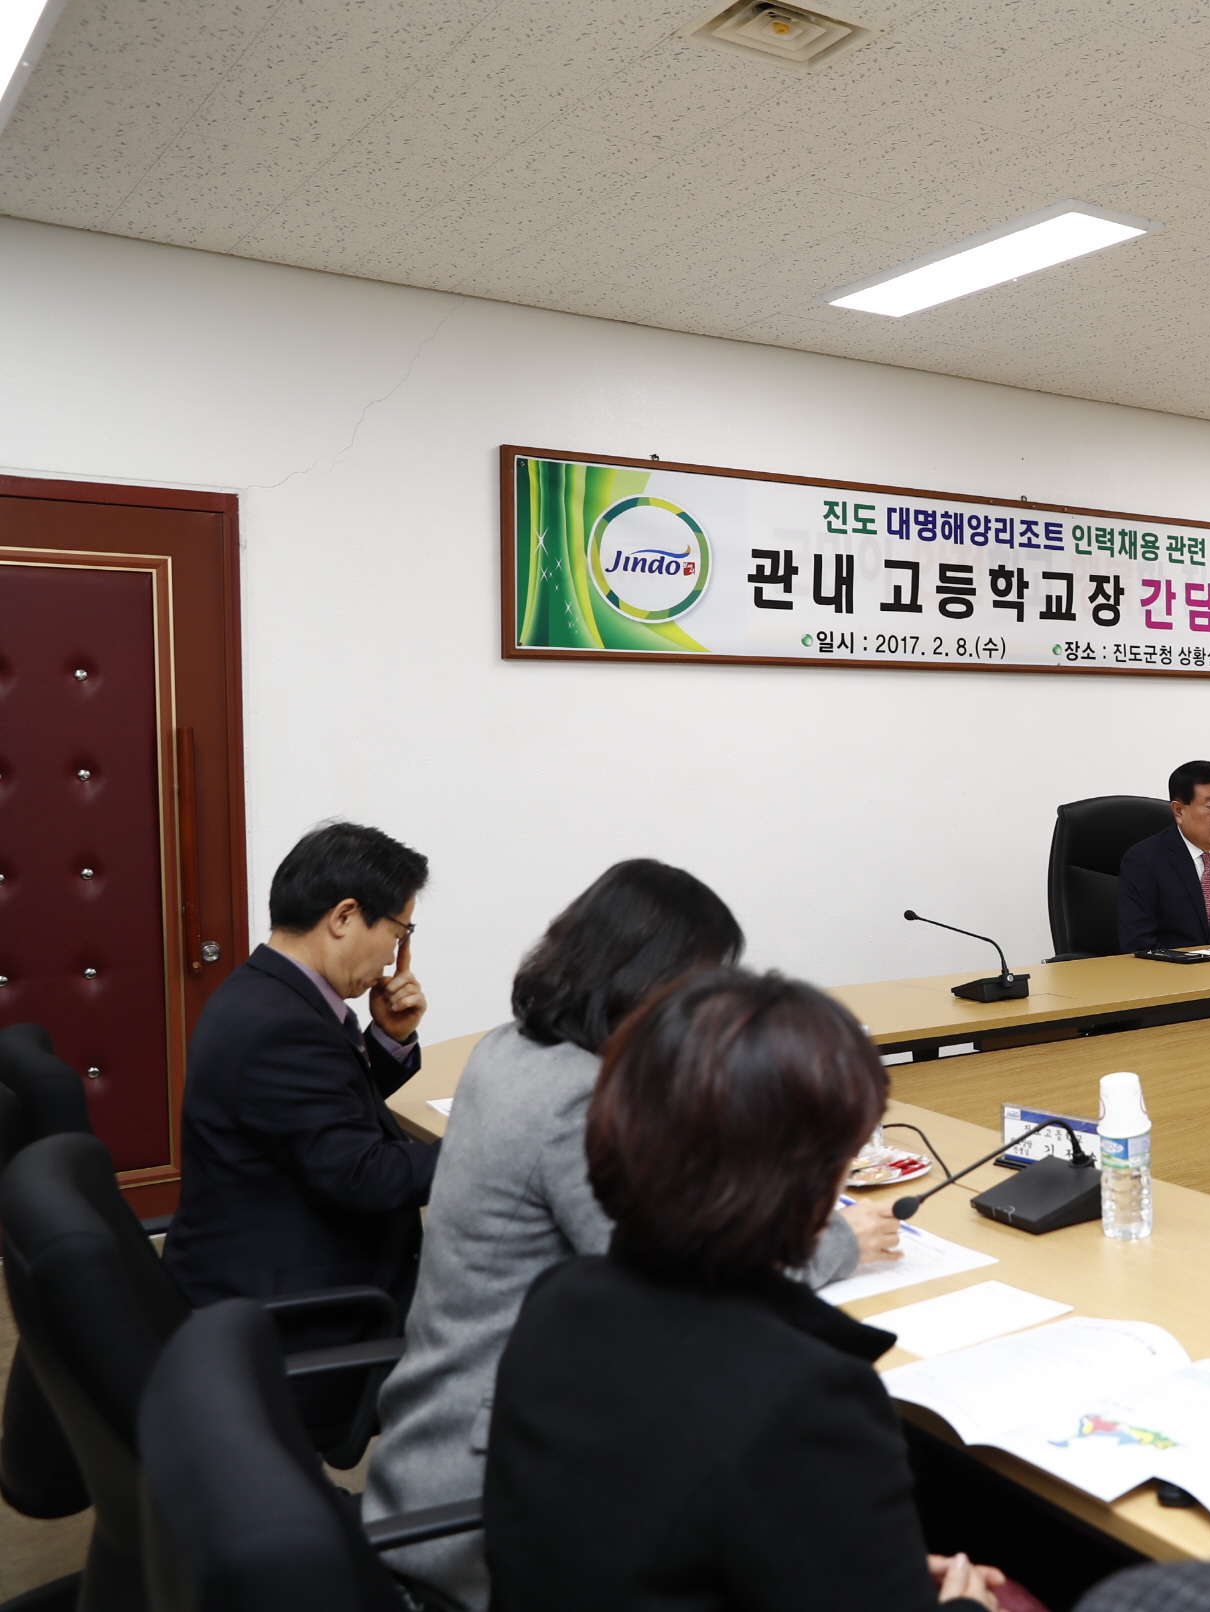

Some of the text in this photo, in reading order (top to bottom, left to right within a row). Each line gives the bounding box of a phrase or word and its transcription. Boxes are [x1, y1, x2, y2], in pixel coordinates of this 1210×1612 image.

[823, 500, 1206, 567] 진도 대명해양리조트 인력채용 관련
[605, 550, 681, 576] Jindo
[747, 548, 855, 615] 관내
[879, 558, 1125, 628] 고등학교장
[816, 630, 855, 654] 일시
[875, 634, 926, 657] 2017.
[932, 636, 950, 658] 2.
[956, 636, 1007, 660] 8.(수)
[1064, 641, 1097, 662] 장소
[1113, 643, 1173, 666] 진도군청
